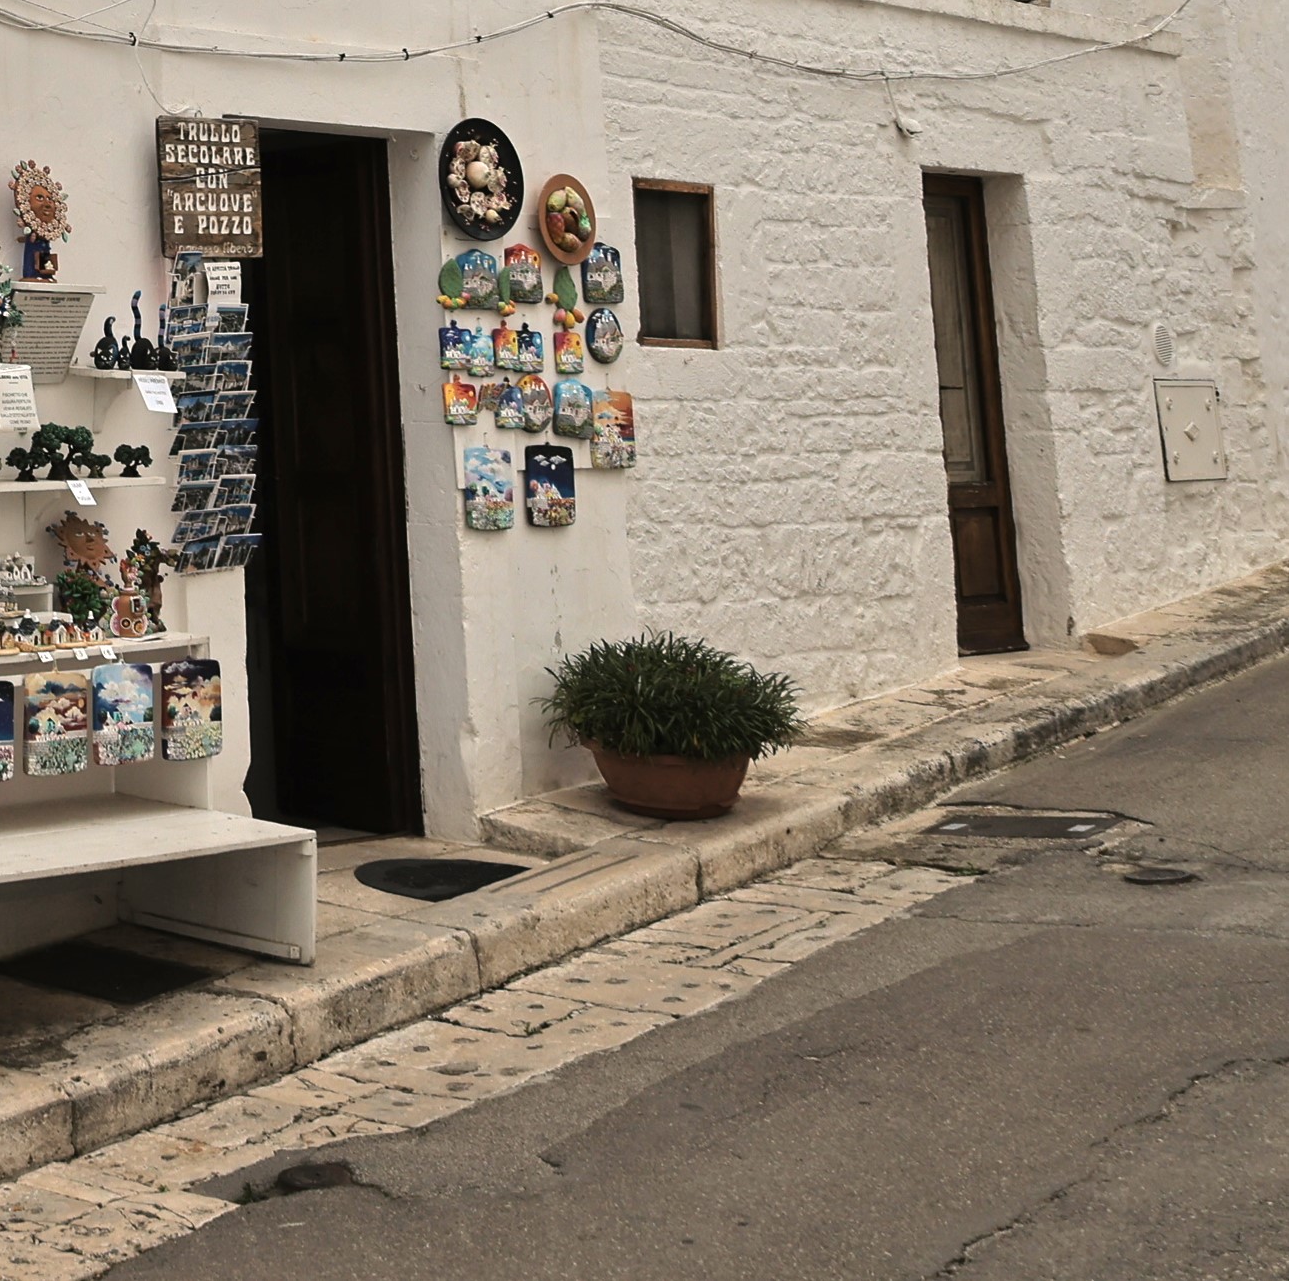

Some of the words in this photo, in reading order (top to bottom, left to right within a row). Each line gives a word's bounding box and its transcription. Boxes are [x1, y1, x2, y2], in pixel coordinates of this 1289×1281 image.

[177, 121, 241, 143] TRULLO
[165, 144, 256, 166] SECOLARE
[195, 167, 228, 189] CON
[174, 215, 184, 234] E
[198, 215, 252, 235] POZZO
